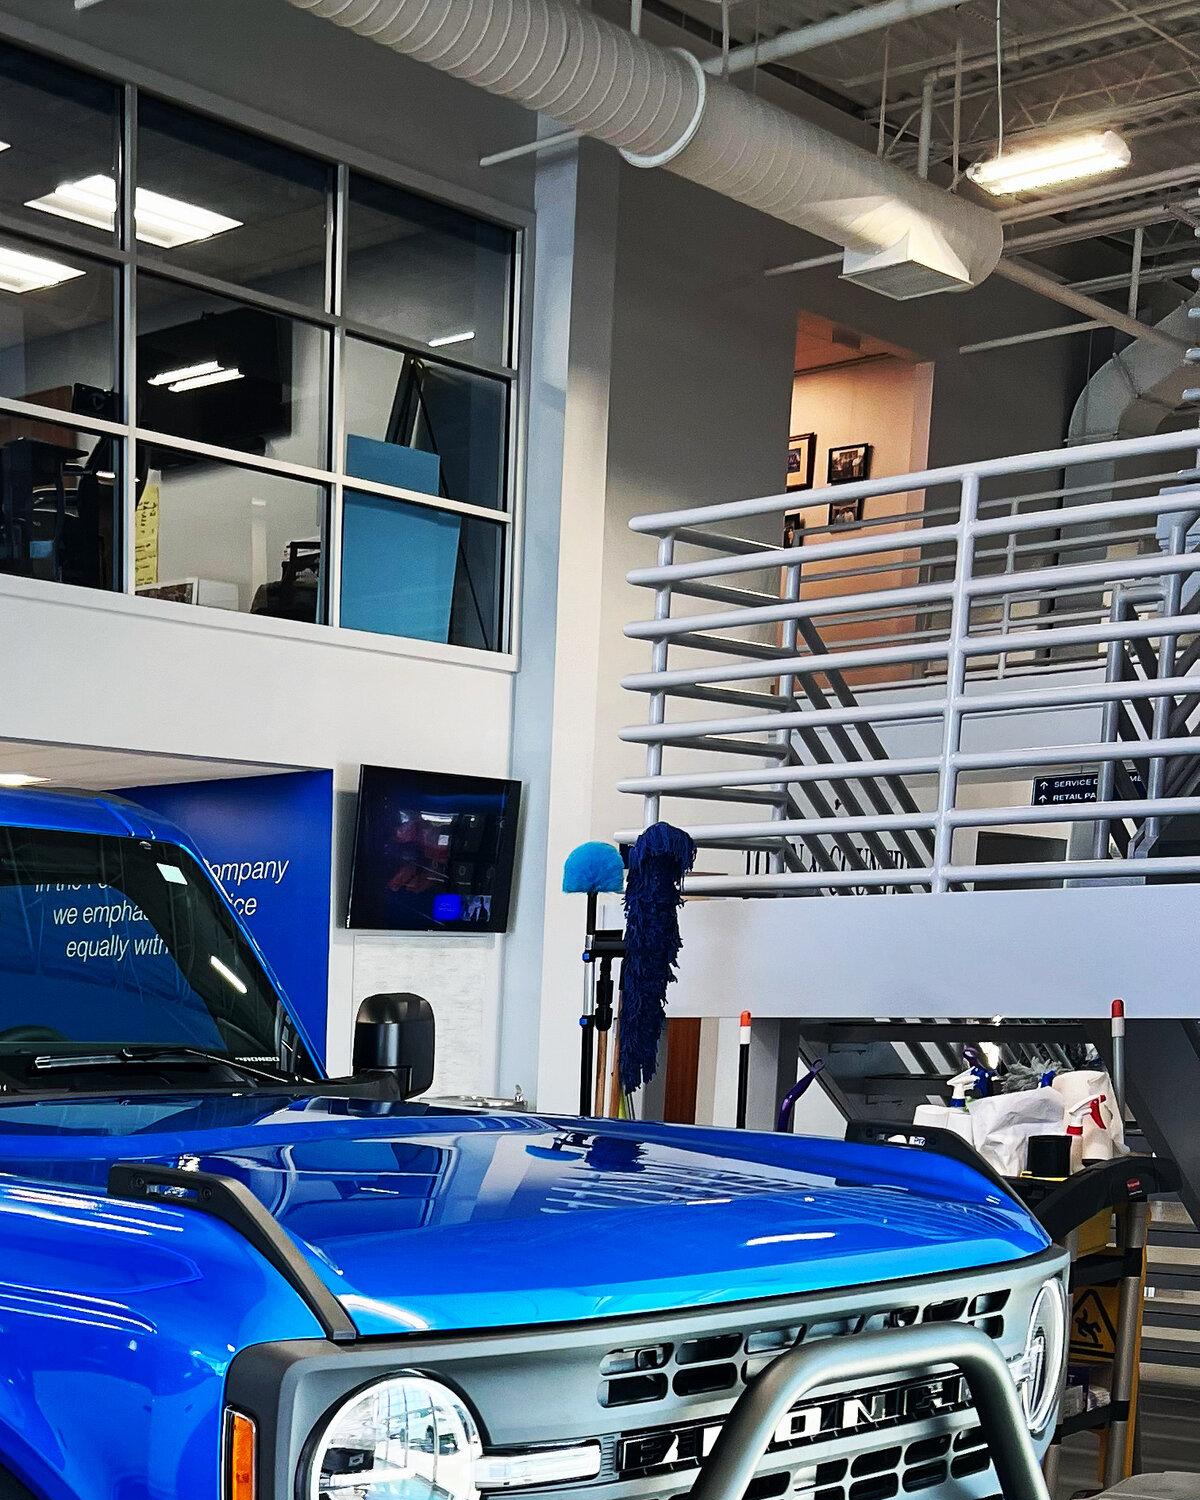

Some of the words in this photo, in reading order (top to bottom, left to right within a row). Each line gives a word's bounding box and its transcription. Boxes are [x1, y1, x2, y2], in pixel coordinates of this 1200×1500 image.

[1054, 778, 1091, 788] SERVICE
[1052, 793, 1082, 802] RETAIL
[205, 860, 289, 886] ompany
[52, 906, 78, 925] we
[66, 934, 130, 962] equally
